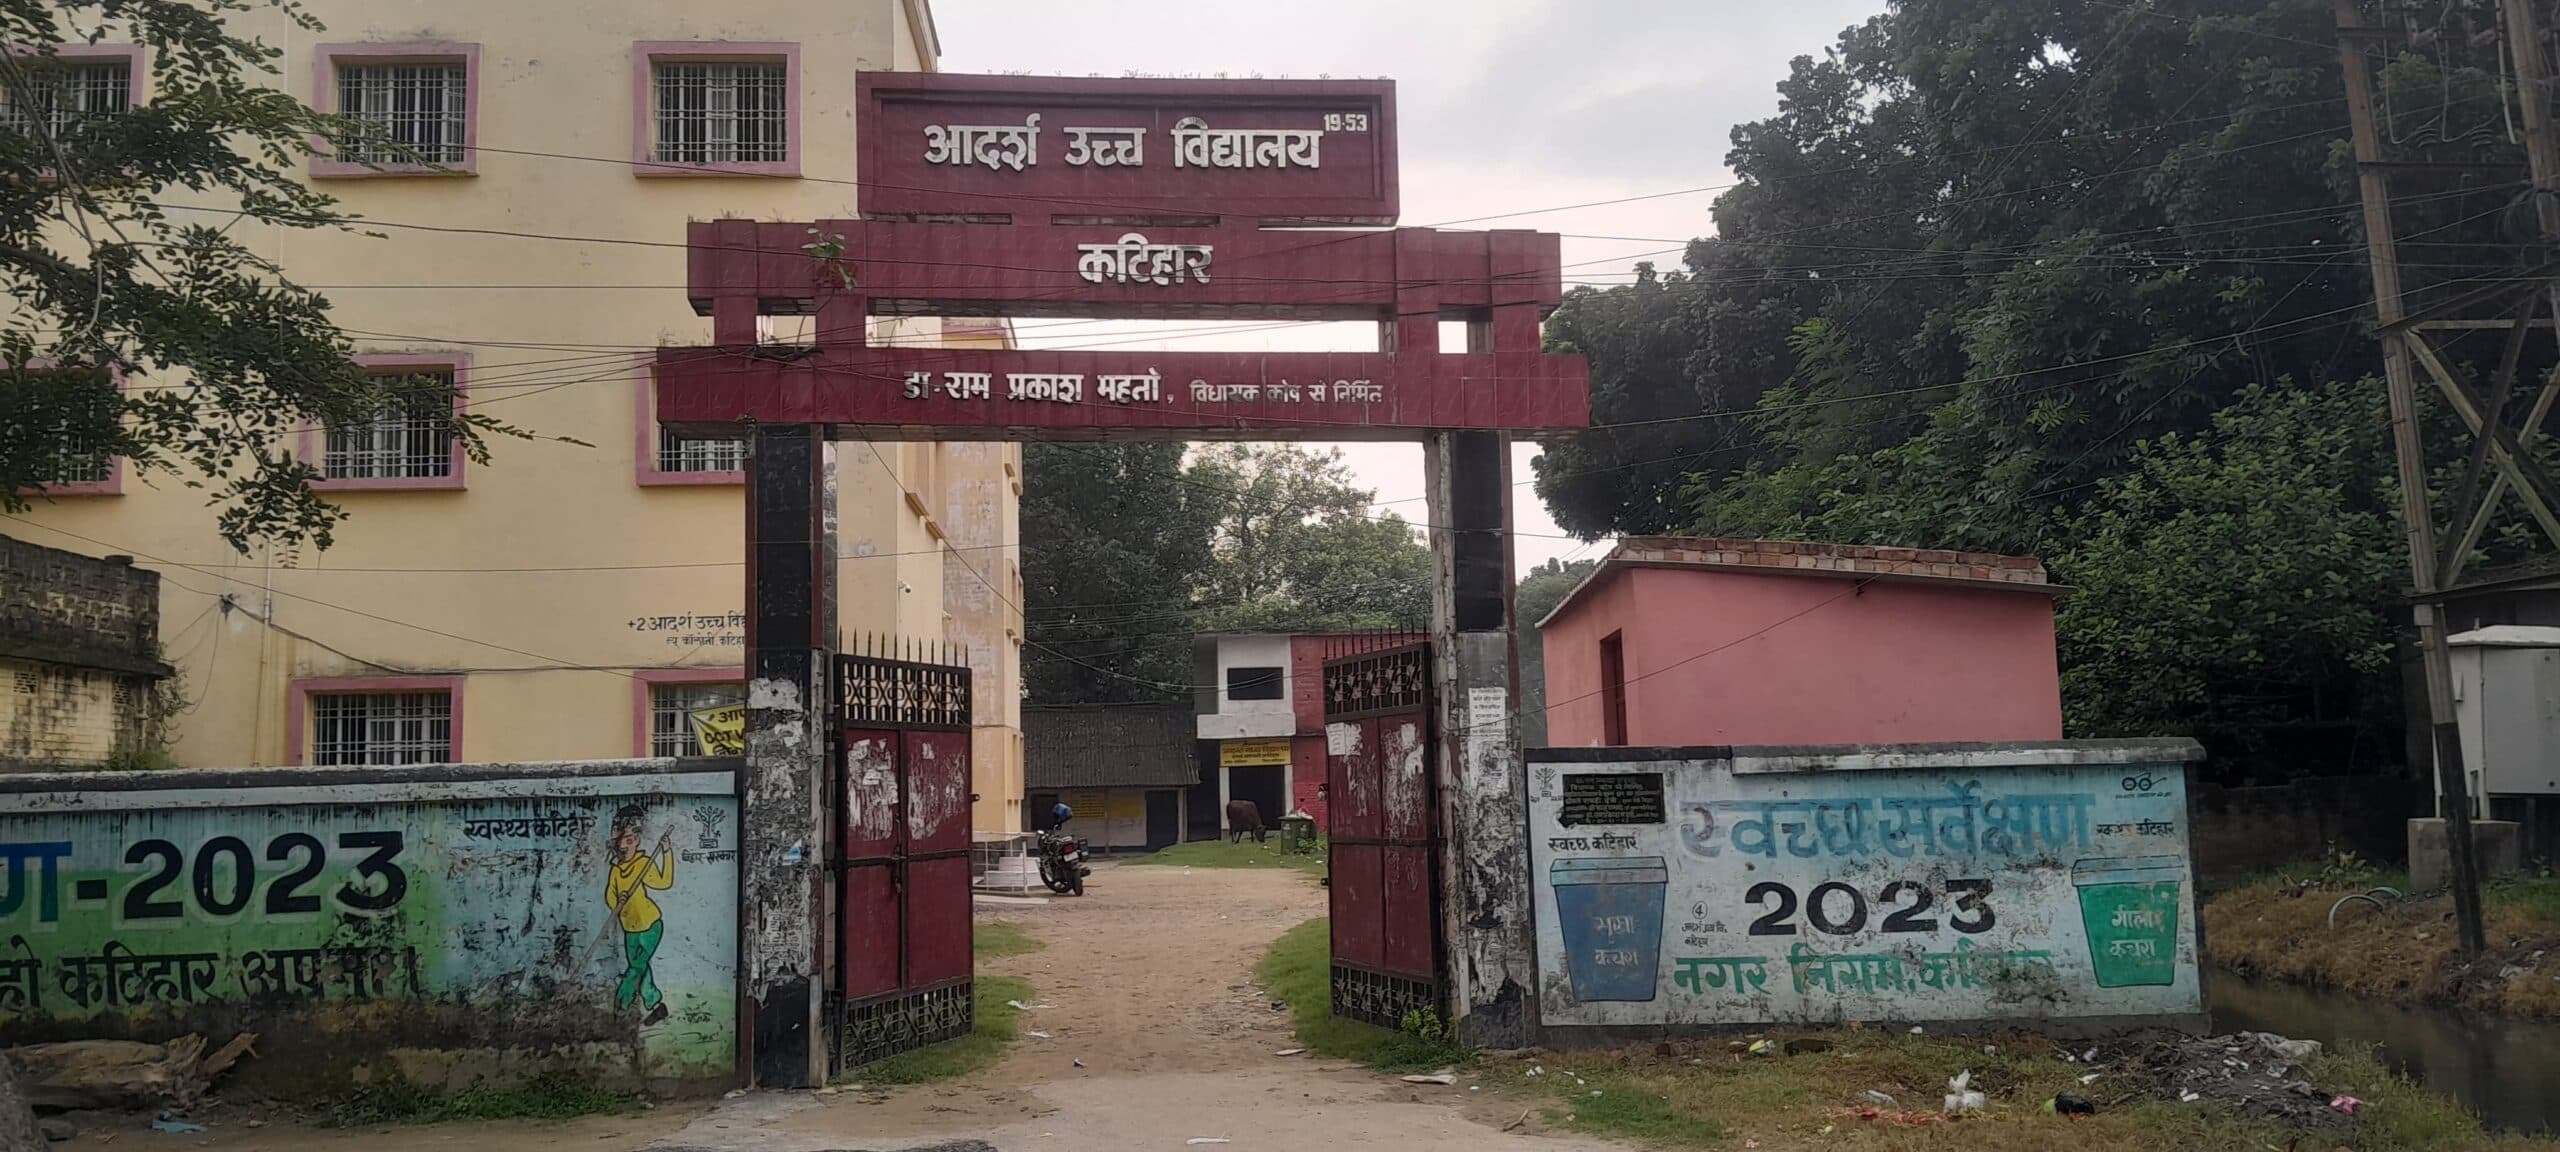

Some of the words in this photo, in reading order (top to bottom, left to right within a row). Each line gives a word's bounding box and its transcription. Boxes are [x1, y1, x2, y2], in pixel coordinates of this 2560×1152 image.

[924, 113, 1040, 172] आदर्श
[1063, 127, 1146, 167] उच्च
[1171, 115, 1324, 169] विद्यालय
[1077, 233, 1213, 284] कटिहार
[1006, 373, 1084, 403] प्रकाश
[1307, 380, 1327, 403] से
[1333, 379, 1383, 403] निर्मित
[694, 616, 724, 630] उच्च
[1592, 832, 1638, 850] कटिहार
[1745, 878, 1996, 936] 2023
[2110, 940, 2156, 957] कचरा
[60, 940, 220, 1008] कटिहार
[1674, 956, 1770, 995] नगर
